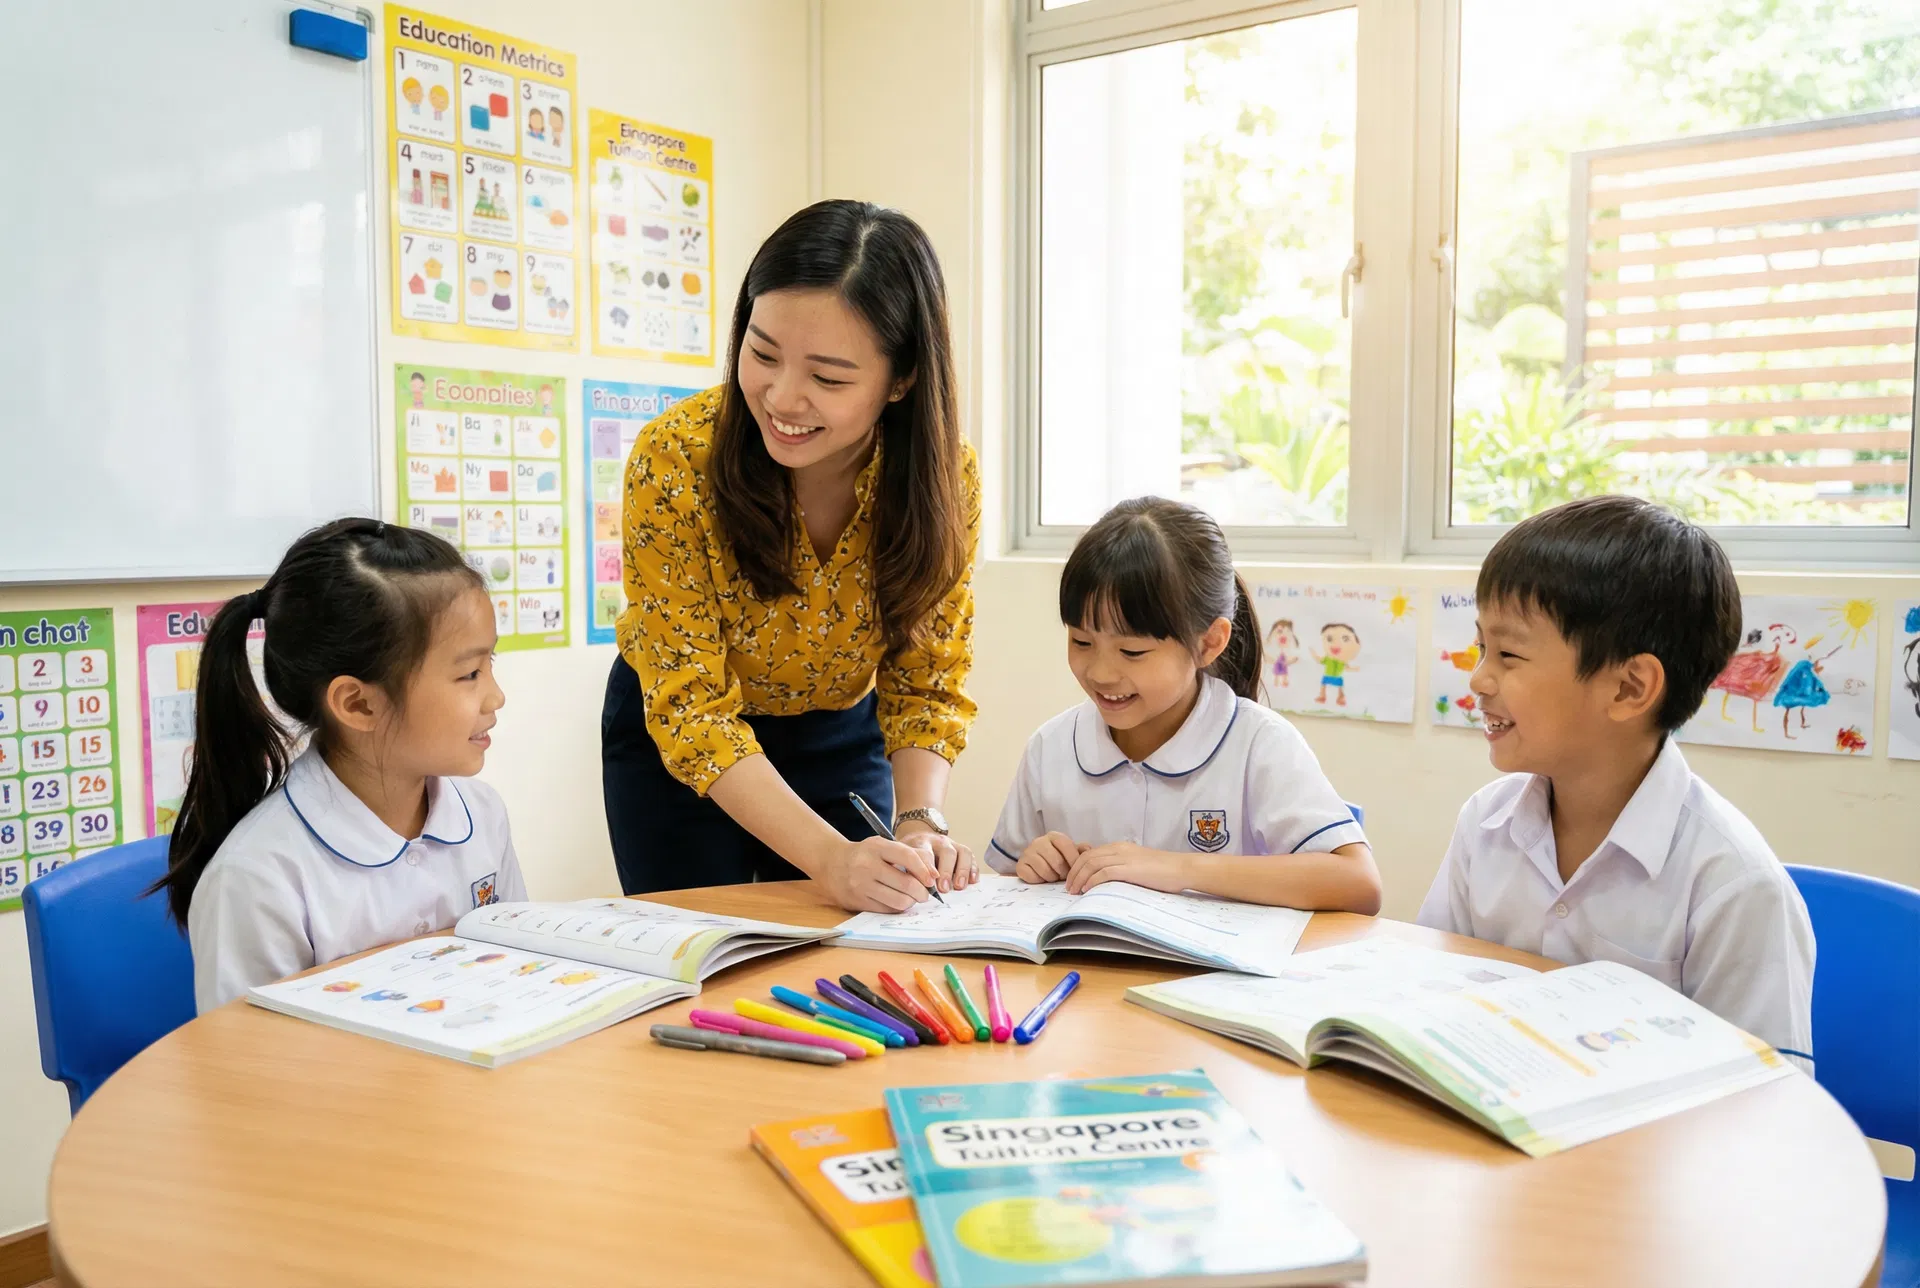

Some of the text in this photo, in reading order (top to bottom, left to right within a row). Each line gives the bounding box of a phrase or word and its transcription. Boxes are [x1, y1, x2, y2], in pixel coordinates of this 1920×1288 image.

[400, 17, 564, 78] Education Metrics
[399, 52, 405, 70] 1
[463, 68, 473, 86] 2
[522, 83, 532, 100] 3
[401, 144, 412, 162] 4
[465, 157, 475, 175] 5
[525, 169, 534, 184] 6
[403, 236, 413, 254] 7
[467, 246, 477, 264] 8
[526, 255, 536, 272] 9
[465, 463, 481, 478] Ny
[467, 508, 482, 521] Kk
[24, 619, 89, 645] chat
[33, 659, 46, 677] 2
[81, 656, 93, 673] 3
[35, 699, 48, 718] 9
[79, 696, 100, 714] 10
[31, 740, 55, 759] 15
[80, 736, 102, 754] 15
[32, 780, 60, 800] 23
[78, 775, 106, 794] 26
[34, 820, 63, 840] 39
[81, 814, 108, 833] 30
[942, 1117, 1201, 1143] Singapore
[954, 1136, 1210, 1162] Tuition Centre
